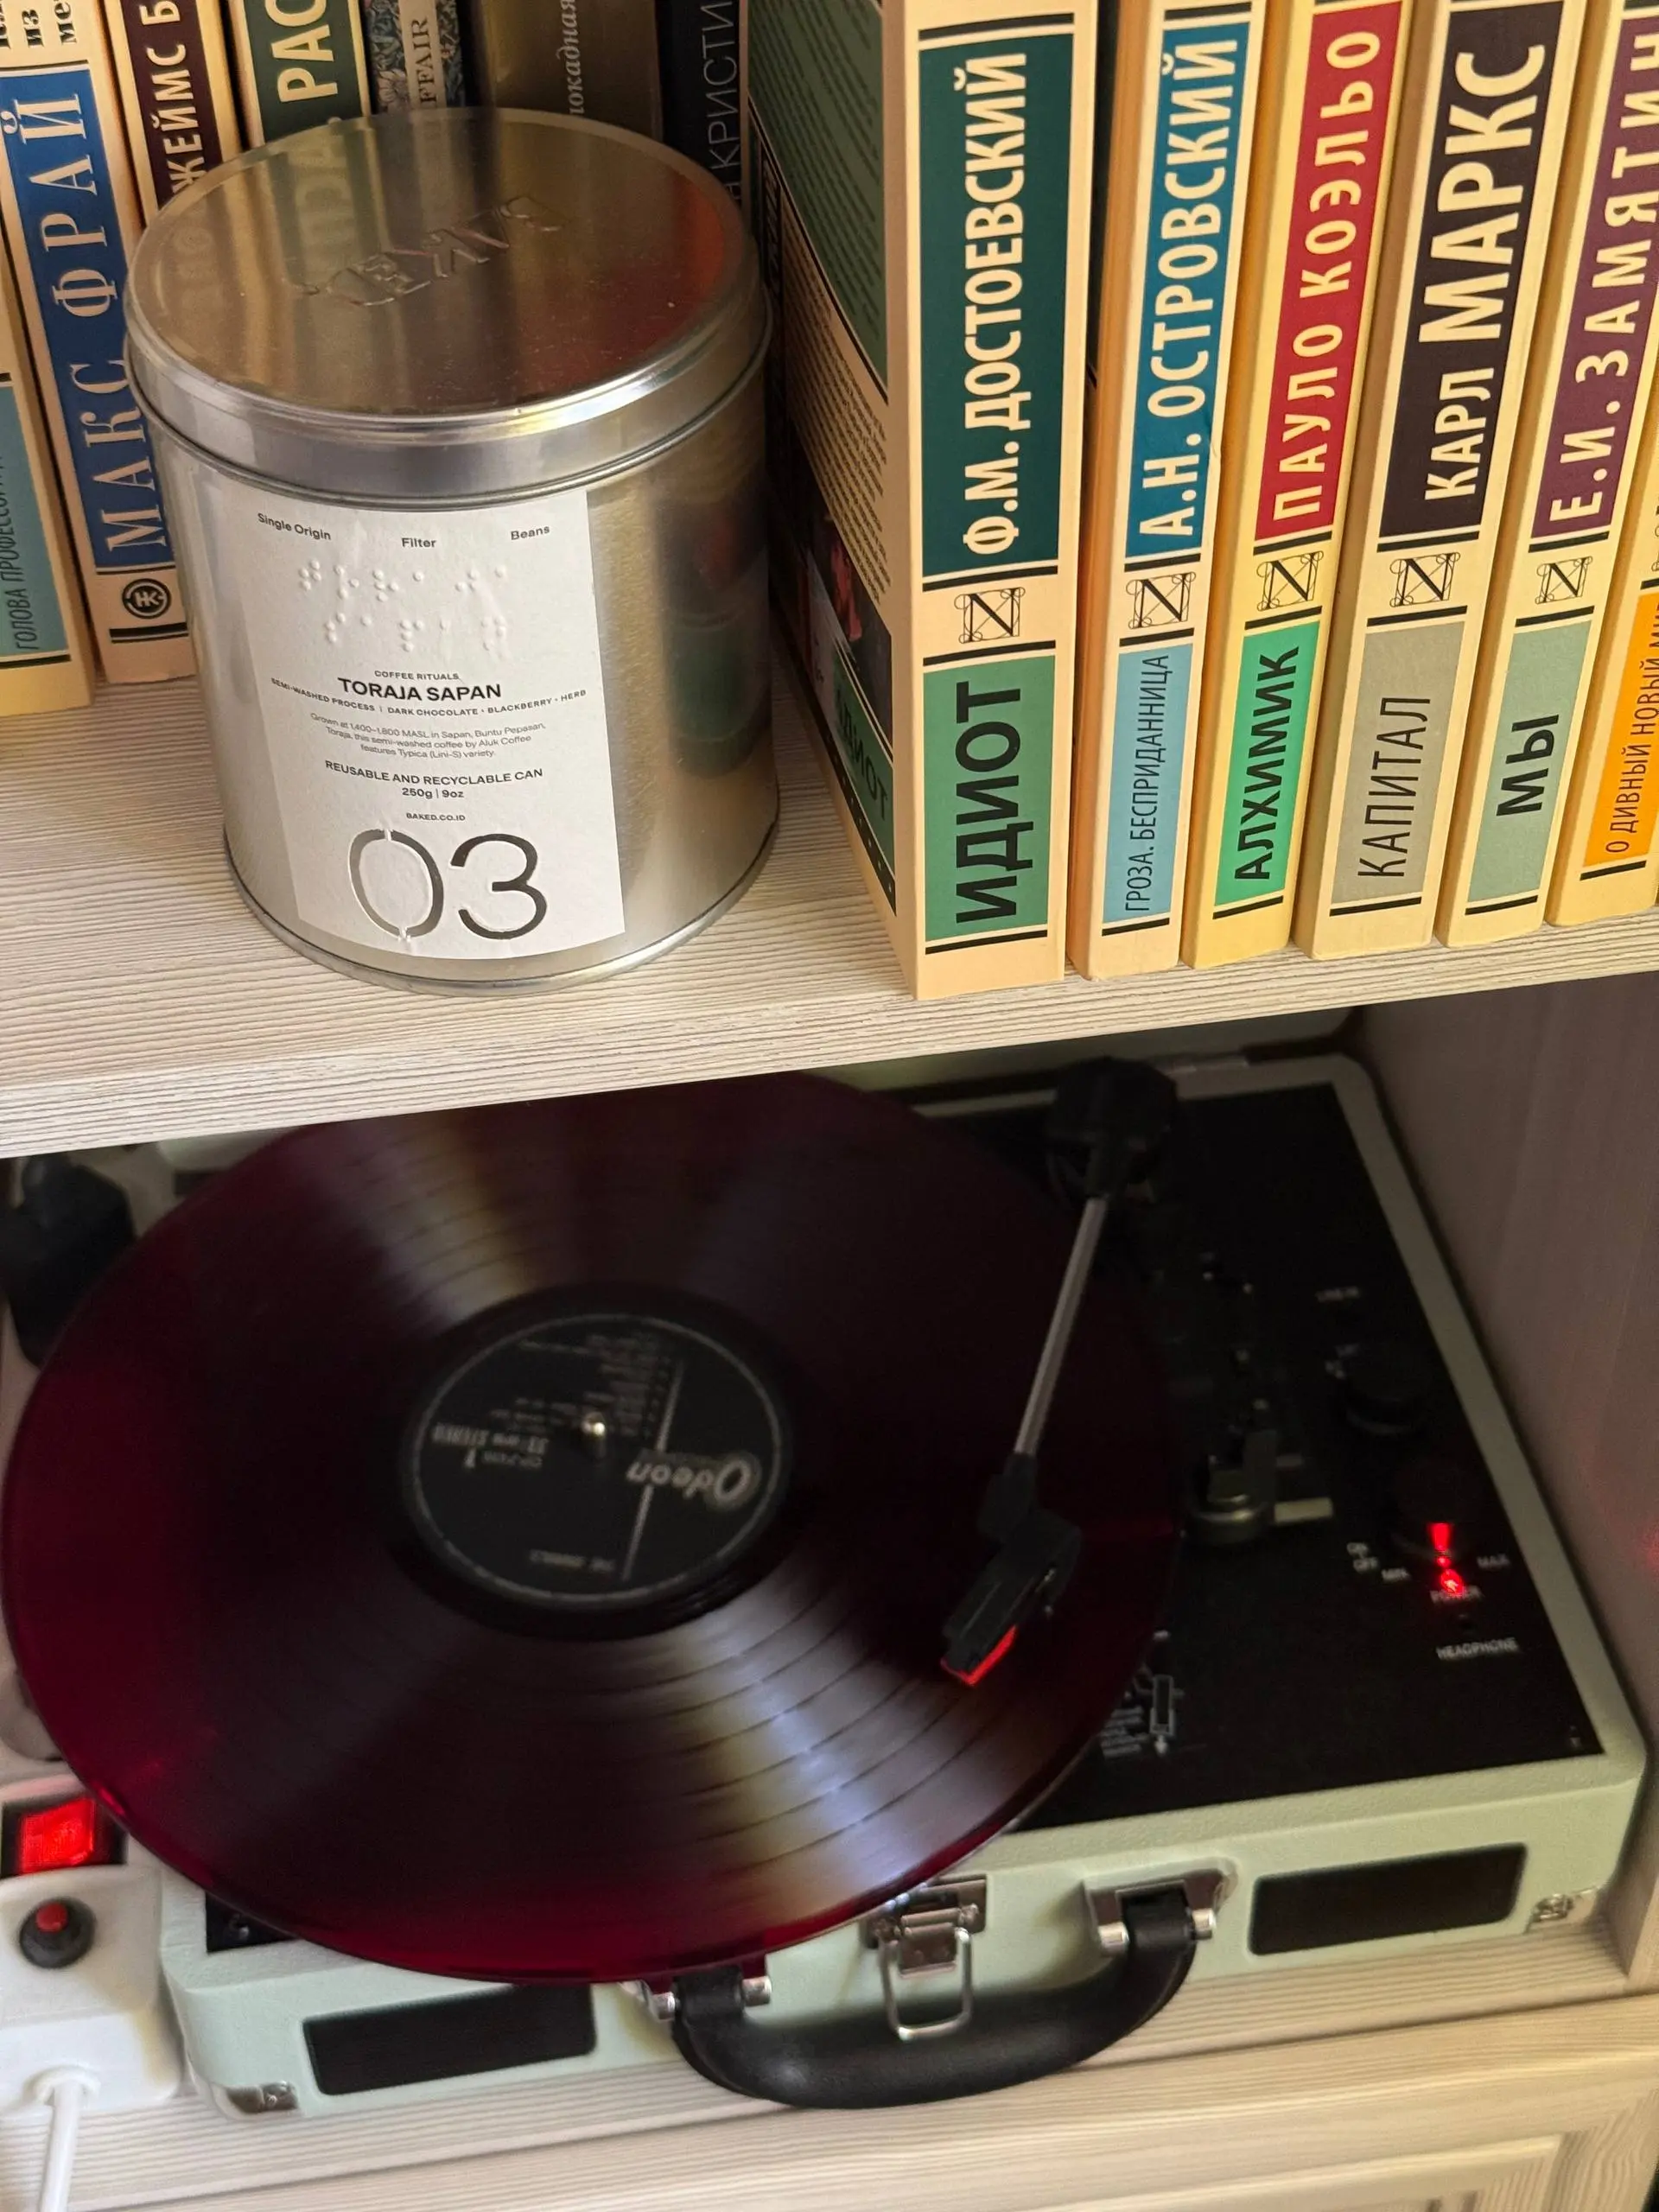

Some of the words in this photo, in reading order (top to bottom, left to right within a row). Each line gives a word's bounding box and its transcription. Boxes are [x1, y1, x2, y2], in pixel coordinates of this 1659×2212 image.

[54, 0, 77, 45] ме
[411, 18, 436, 105] FFAIR
[146, 44, 207, 194] ЖЕЙМС
[701, 1, 741, 169] КРИСТИ
[2, 92, 118, 317] ФРАЙ
[1300, 30, 1380, 298] КОЭЛЬО
[1418, 45, 1545, 344] МАРКС
[953, 53, 1032, 430] ДОСТОЕВСКИЙ
[1147, 40, 1237, 418] ОСТРОВСКИЙ
[69, 359, 167, 551] МАКС
[1274, 323, 1343, 521] ПАУЛО
[1425, 367, 1495, 500] КАРЛ
[1549, 401, 1621, 522] Е.И.
[257, 512, 291, 533] Single
[294, 524, 332, 541] Origin
[511, 524, 550, 541] Beans
[963, 440, 1020, 555] Ф.М.
[1139, 432, 1201, 537] А.Н.
[402, 537, 436, 549] Filter
[7, 588, 39, 650] ГОЛОВА
[270, 677, 330, 703] SEMI-WASHED
[332, 697, 375, 711] PROCESS
[387, 707, 414, 715] DARK
[487, 697, 552, 714] BLACKBERRY
[561, 690, 587, 702] HERB
[310, 712, 339, 727] Grown
[337, 677, 423, 701] TORAJA
[427, 683, 501, 702] SAPAN
[374, 670, 414, 680] COFFEE
[325, 760, 390, 782] REUSABLE
[392, 773, 420, 785] AND
[423, 773, 512, 785] RECYCLABLE
[514, 768, 543, 779] CAN
[354, 732, 370, 741] this
[371, 734, 432, 748] semi-washed
[465, 740, 477, 750] by
[500, 735, 531, 746] Coffee
[360, 744, 397, 756] features
[398, 748, 428, 760] Typica
[1129, 654, 1170, 841] БЕСПРИДАННИЦА
[1235, 646, 1299, 880] АЛХИМИК
[1357, 697, 1431, 878] КАПИТАЛ
[1496, 715, 1560, 817] МЫ
[1611, 744, 1652, 834] ДИВНЫЙ
[402, 787, 433, 799] 250g
[442, 789, 465, 798] 9oz
[406, 812, 466, 822] BAKED.CO.ID
[956, 681, 1034, 924] ИДИОТ
[347, 828, 548, 942] 03
[1125, 846, 1154, 912] ГРОЗА.
[1605, 841, 1630, 854] О
